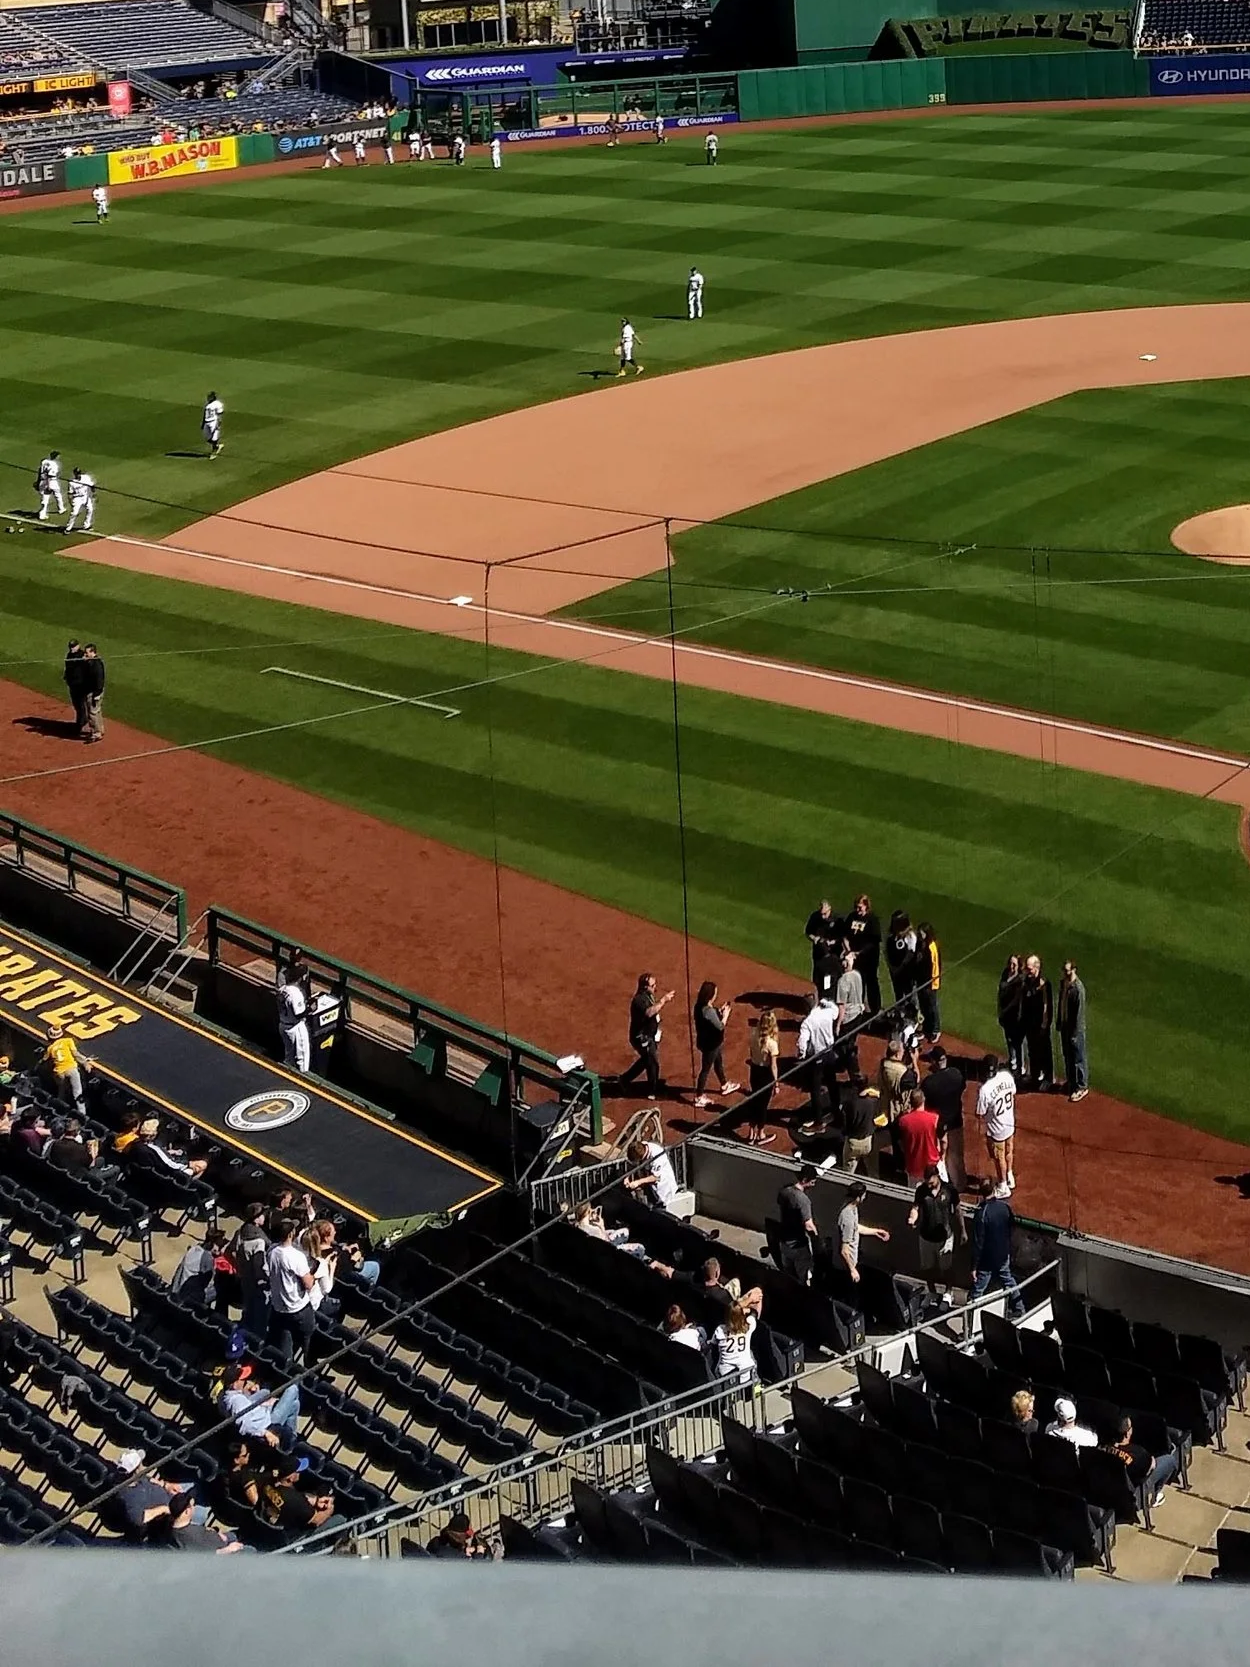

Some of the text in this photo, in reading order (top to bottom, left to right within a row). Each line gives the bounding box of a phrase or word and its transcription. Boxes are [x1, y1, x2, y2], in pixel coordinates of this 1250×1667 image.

[450, 64, 525, 76] GUARDIAN
[60, 76, 93, 87] LIGHT
[928, 93, 946, 104] 399
[688, 115, 723, 125] GUARDIAN
[519, 129, 556, 138] GUARDIAN
[293, 135, 322, 149] AT&T
[3, 164, 55, 186] DALE
[996, 1091, 1012, 1116] 29
[726, 1336, 746, 1353] 29
